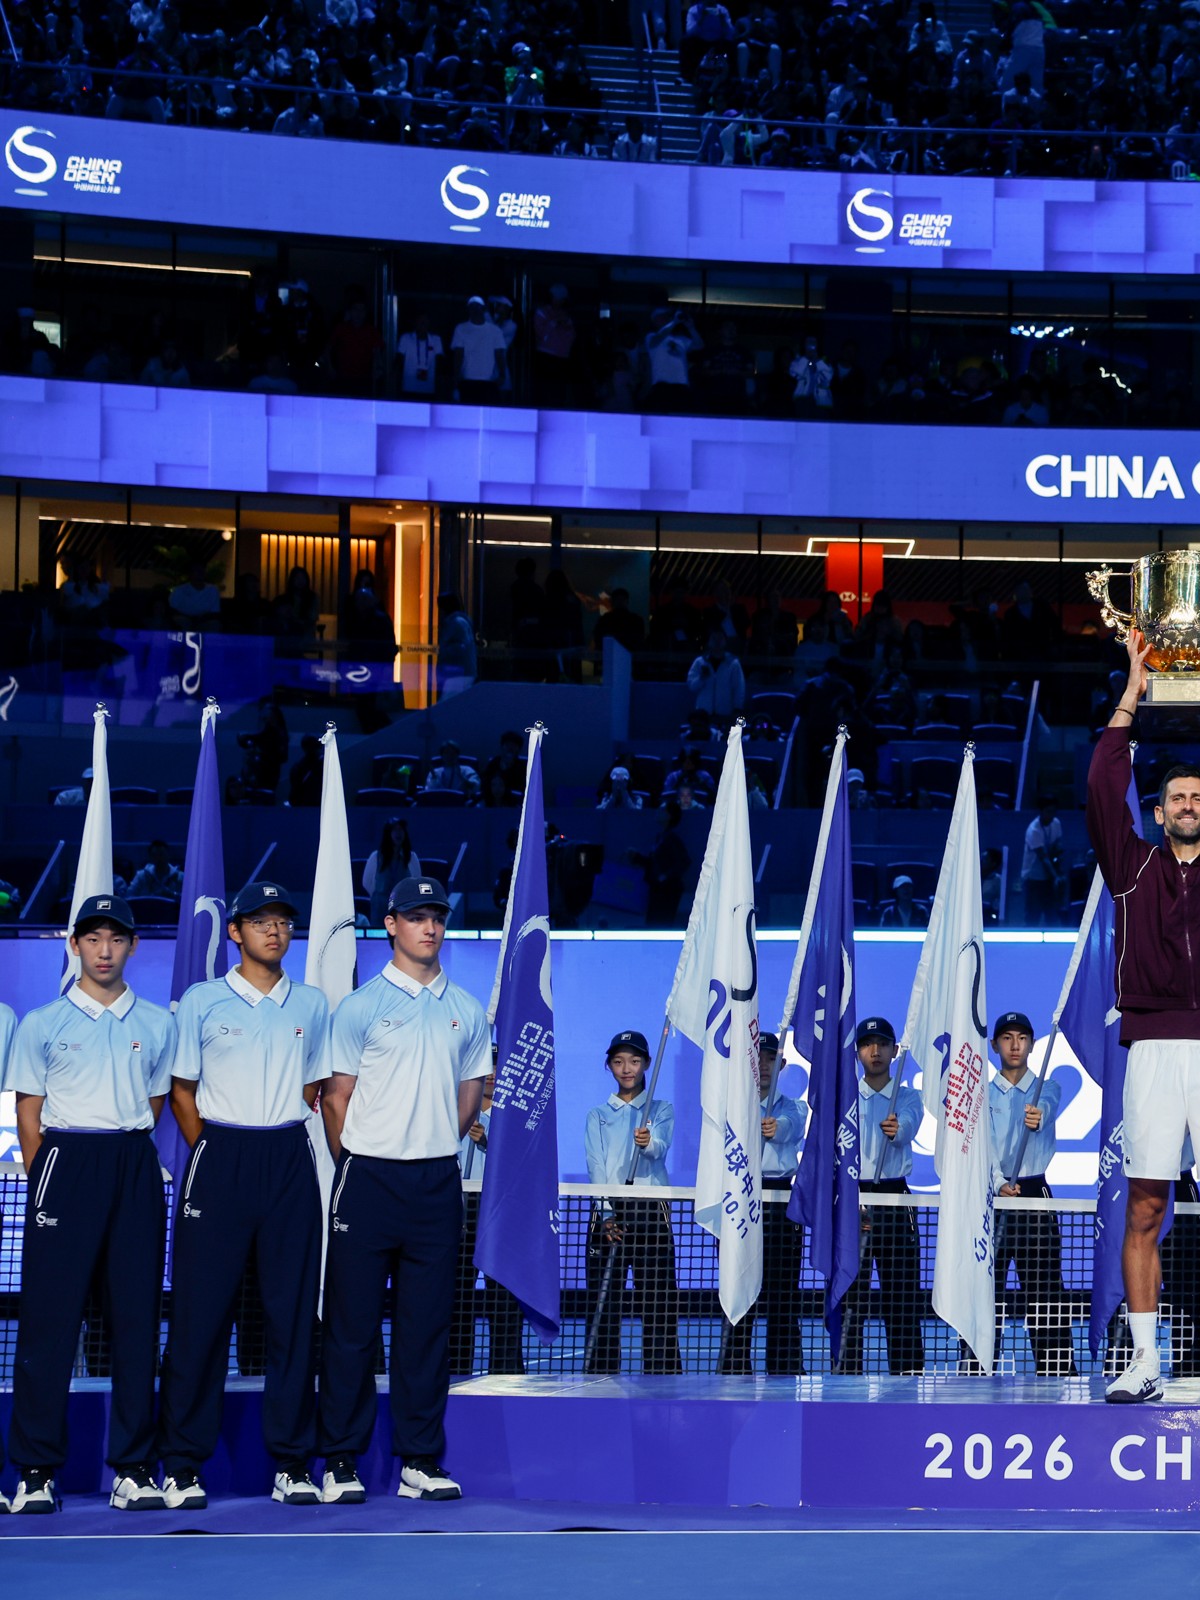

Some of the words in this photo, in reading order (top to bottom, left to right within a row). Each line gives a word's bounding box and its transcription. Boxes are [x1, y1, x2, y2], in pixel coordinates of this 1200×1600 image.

[66, 156, 122, 174] CHINA
[63, 169, 116, 186] OPEN
[498, 192, 551, 208] CHINA
[495, 205, 545, 220] OPEN
[901, 213, 953, 227] CHINA
[899, 225, 946, 239] OPEN
[1025, 455, 1185, 500] CHINA
[722, 1191, 748, 1239] 10.11
[924, 1432, 1074, 1481] 2026
